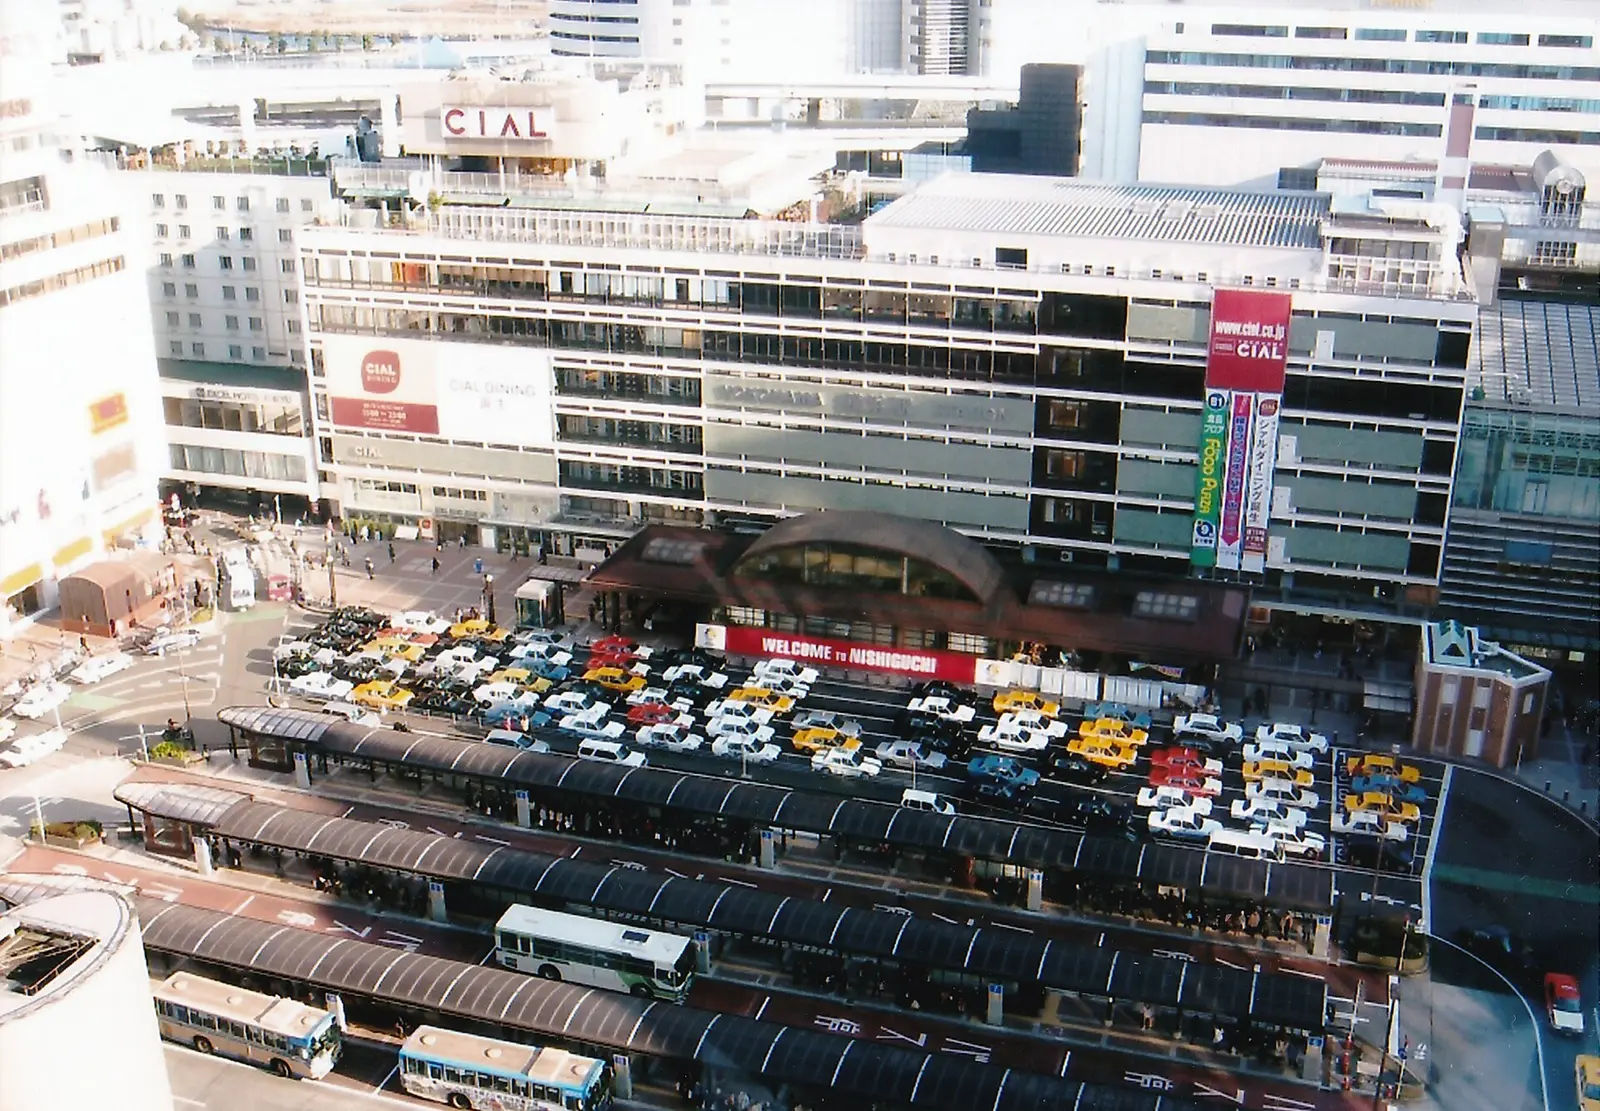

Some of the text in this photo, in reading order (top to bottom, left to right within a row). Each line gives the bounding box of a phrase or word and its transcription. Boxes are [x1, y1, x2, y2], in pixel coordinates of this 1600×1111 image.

[445, 109, 547, 137] CIAL
[1215, 321, 1285, 341] www.cial.co.jp
[1237, 343, 1283, 360] CIAL
[365, 362, 397, 376] CIAL
[1210, 396, 1222, 407] B1
[762, 637, 832, 660] WELCOME
[849, 647, 937, 673] NISHIGUCHI
